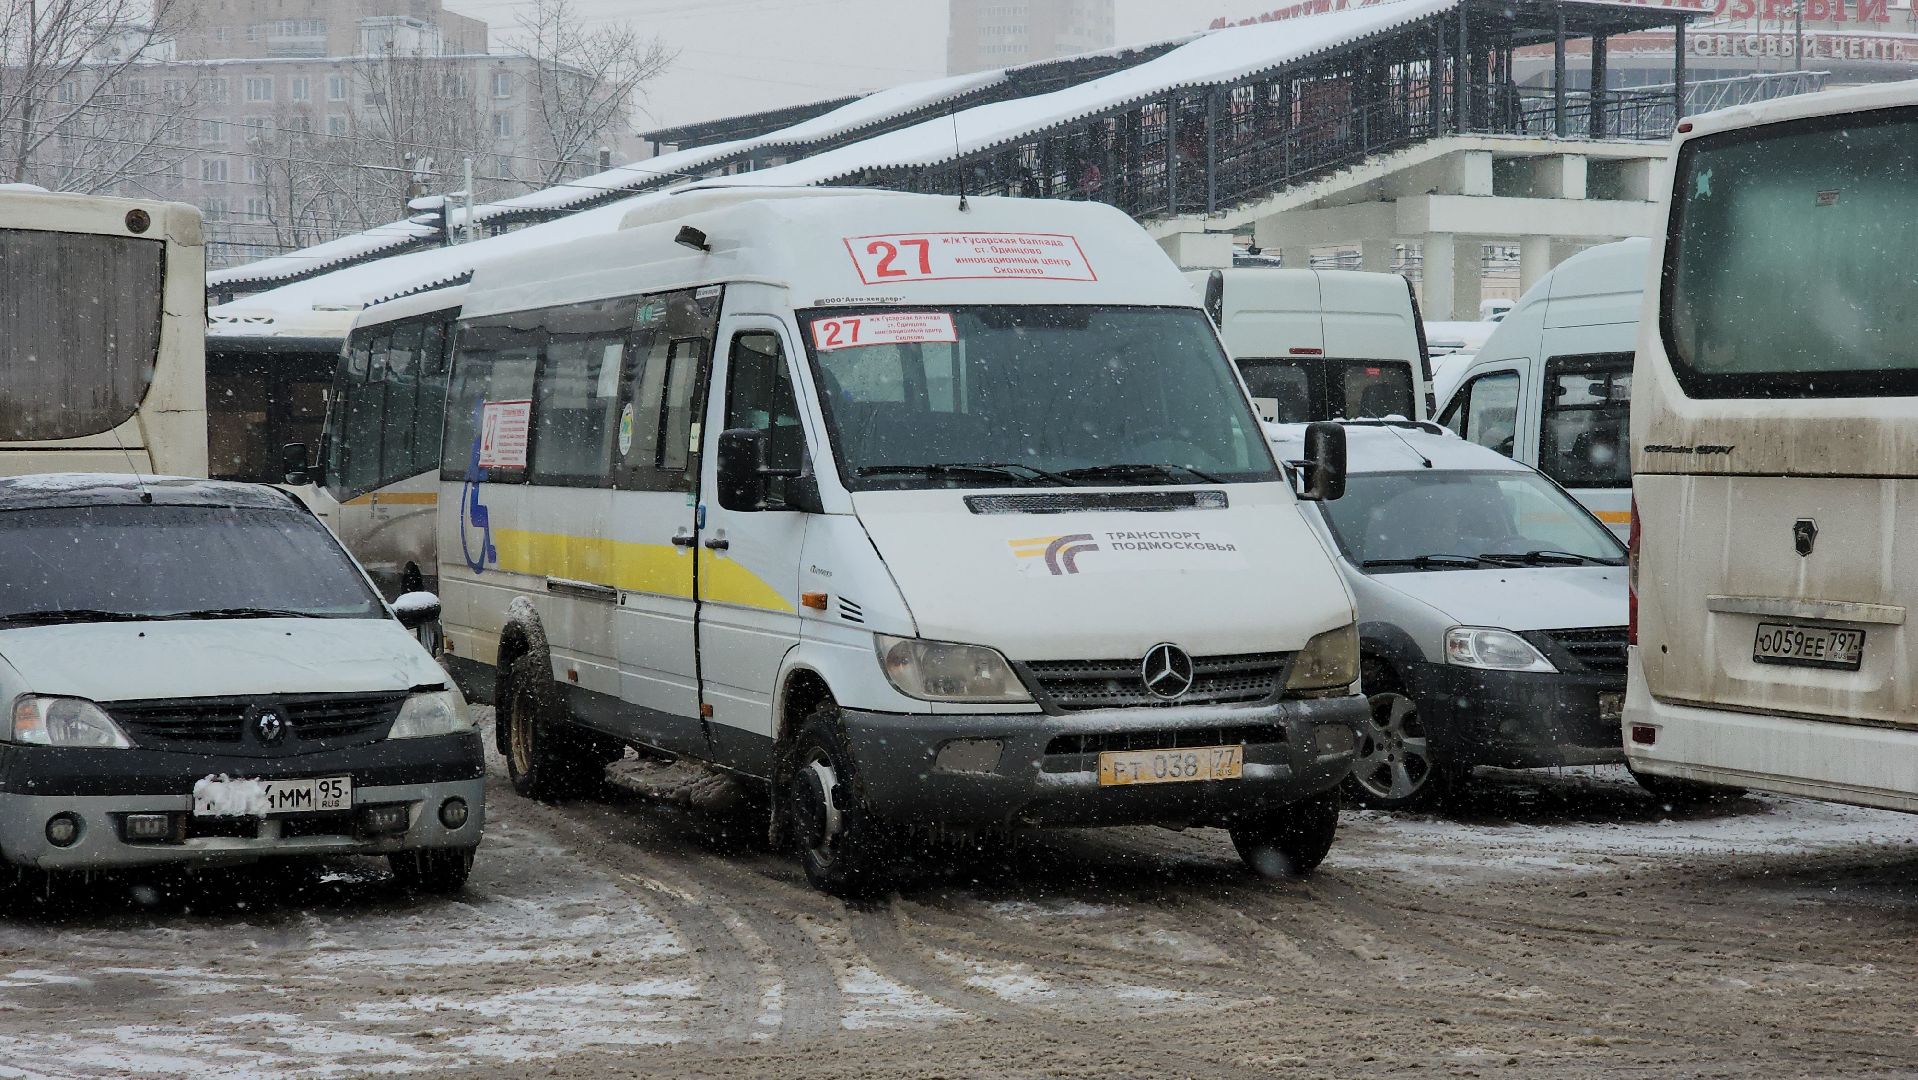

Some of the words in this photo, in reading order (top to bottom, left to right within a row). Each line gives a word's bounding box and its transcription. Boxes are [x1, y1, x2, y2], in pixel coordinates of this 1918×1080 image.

[1686, 34, 1818, 57] ОРГОВЫЙ
[963, 236, 1017, 245] Гусарская
[1018, 237, 1064, 247] баллада
[990, 246, 1042, 255] Одинцово
[867, 239, 931, 277] 27
[954, 257, 1038, 265] инновационный
[1040, 257, 1071, 267] центр
[993, 266, 1044, 275] Сколково
[823, 319, 861, 346] 27
[1106, 531, 1201, 541] ТРАНСПОРТ
[1112, 542, 1237, 552] ПОДМОСКОВЬЯ
[1829, 632, 1857, 653] 797
[1154, 753, 1198, 778] 038
[1214, 749, 1235, 768] 77
[318, 780, 343, 799] 95
[321, 800, 340, 808] RUS
